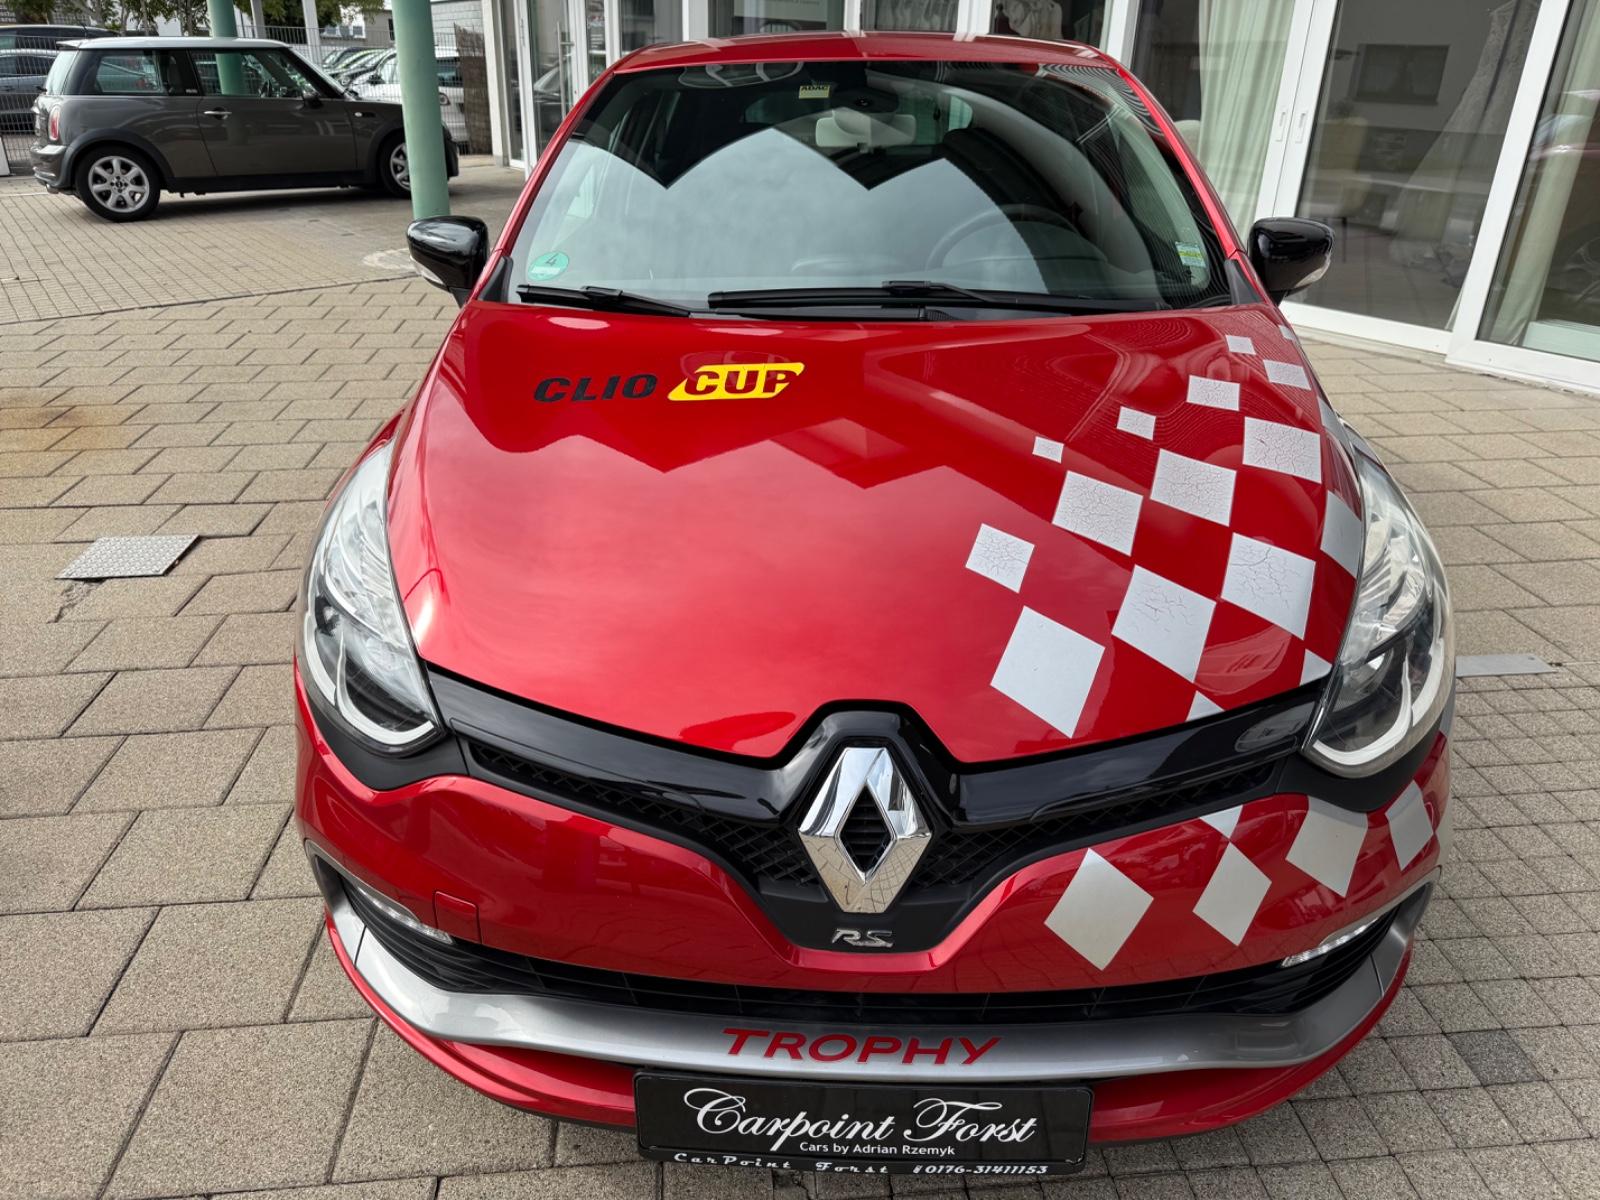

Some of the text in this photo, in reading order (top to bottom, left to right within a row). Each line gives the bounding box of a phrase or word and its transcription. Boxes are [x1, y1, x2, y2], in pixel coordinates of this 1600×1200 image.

[545, 253, 558, 266] 4
[534, 369, 797, 402] CLIO CUP
[831, 928, 894, 948] RS
[722, 1028, 1001, 1065] TROPHY
[684, 1087, 1037, 1151] Carpoint Forst
[799, 1142, 956, 1157] Cars by Adrian Rzemyk
[815, 1161, 889, 1174] Forst
